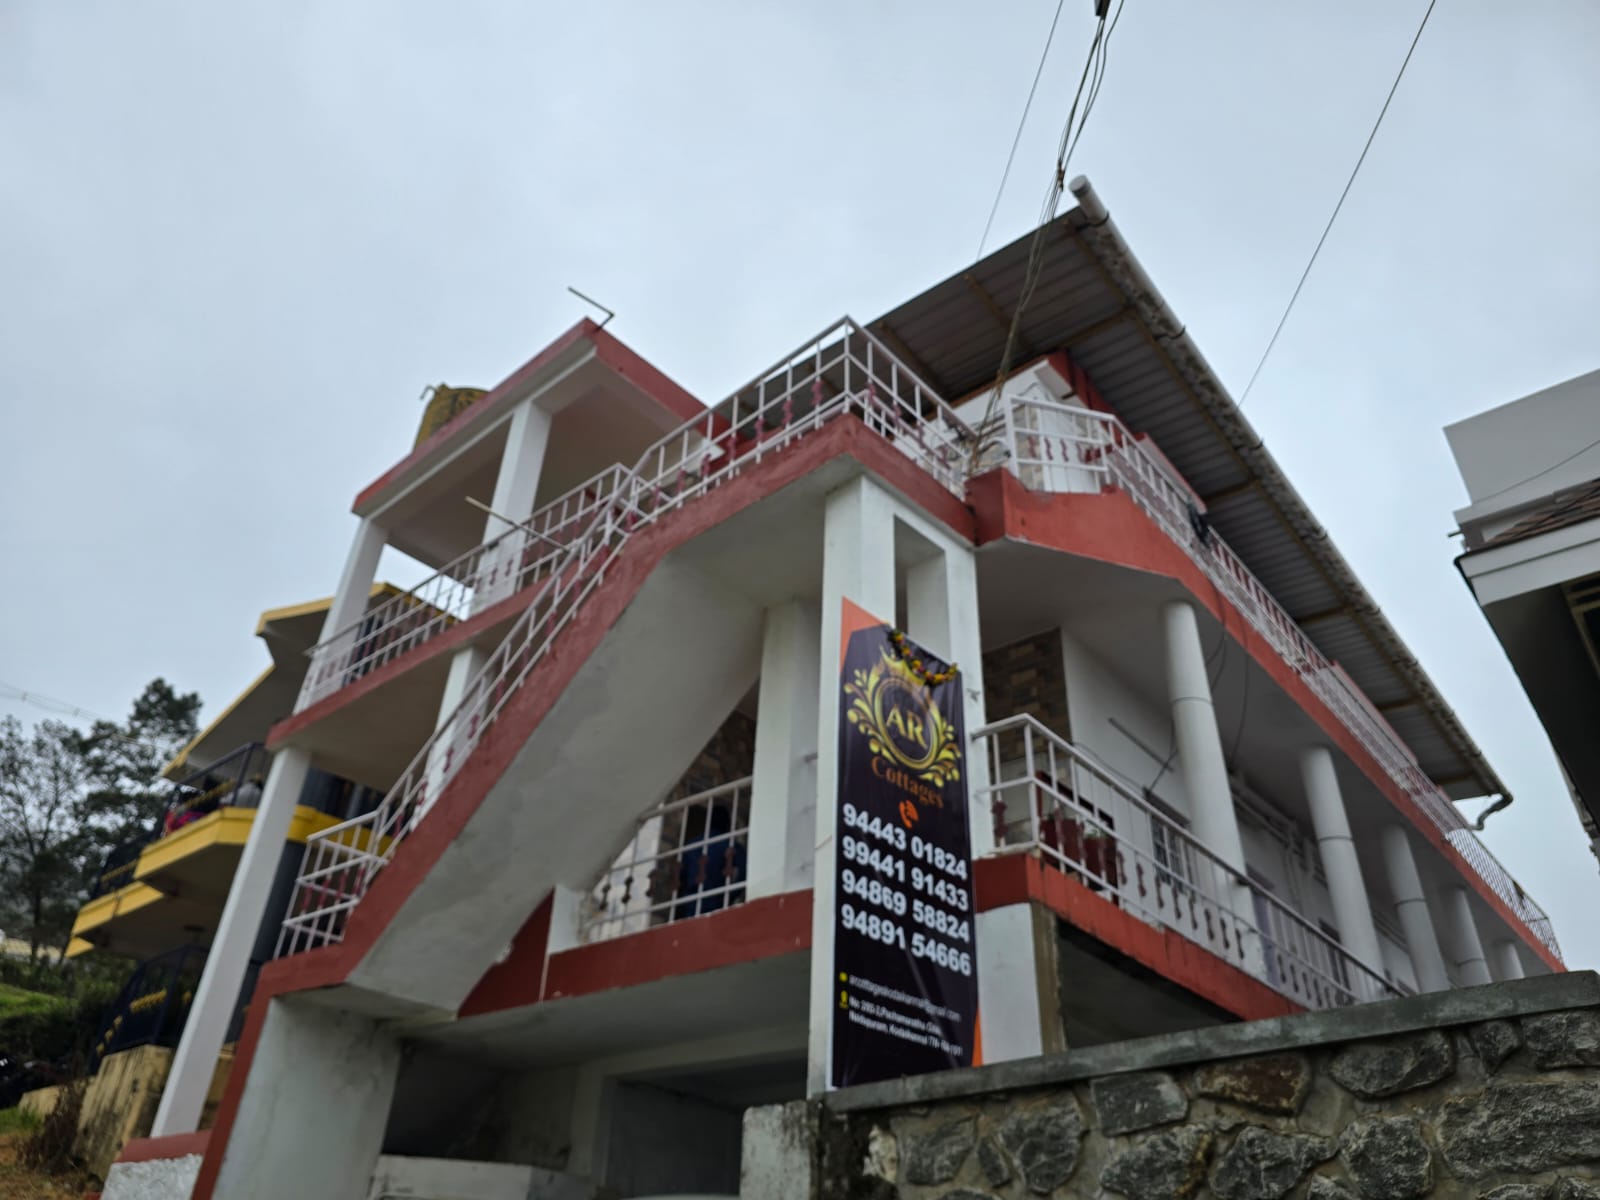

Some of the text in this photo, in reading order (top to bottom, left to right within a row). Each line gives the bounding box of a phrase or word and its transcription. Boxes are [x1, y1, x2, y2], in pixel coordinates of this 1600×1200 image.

[886, 703, 928, 749] AR
[871, 755, 943, 808] Cottages
[842, 835, 968, 911] 99441 91433
[843, 803, 967, 880] 94443 01824
[841, 904, 971, 976] 94891 54666
[842, 869, 970, 942] 94869 58824
